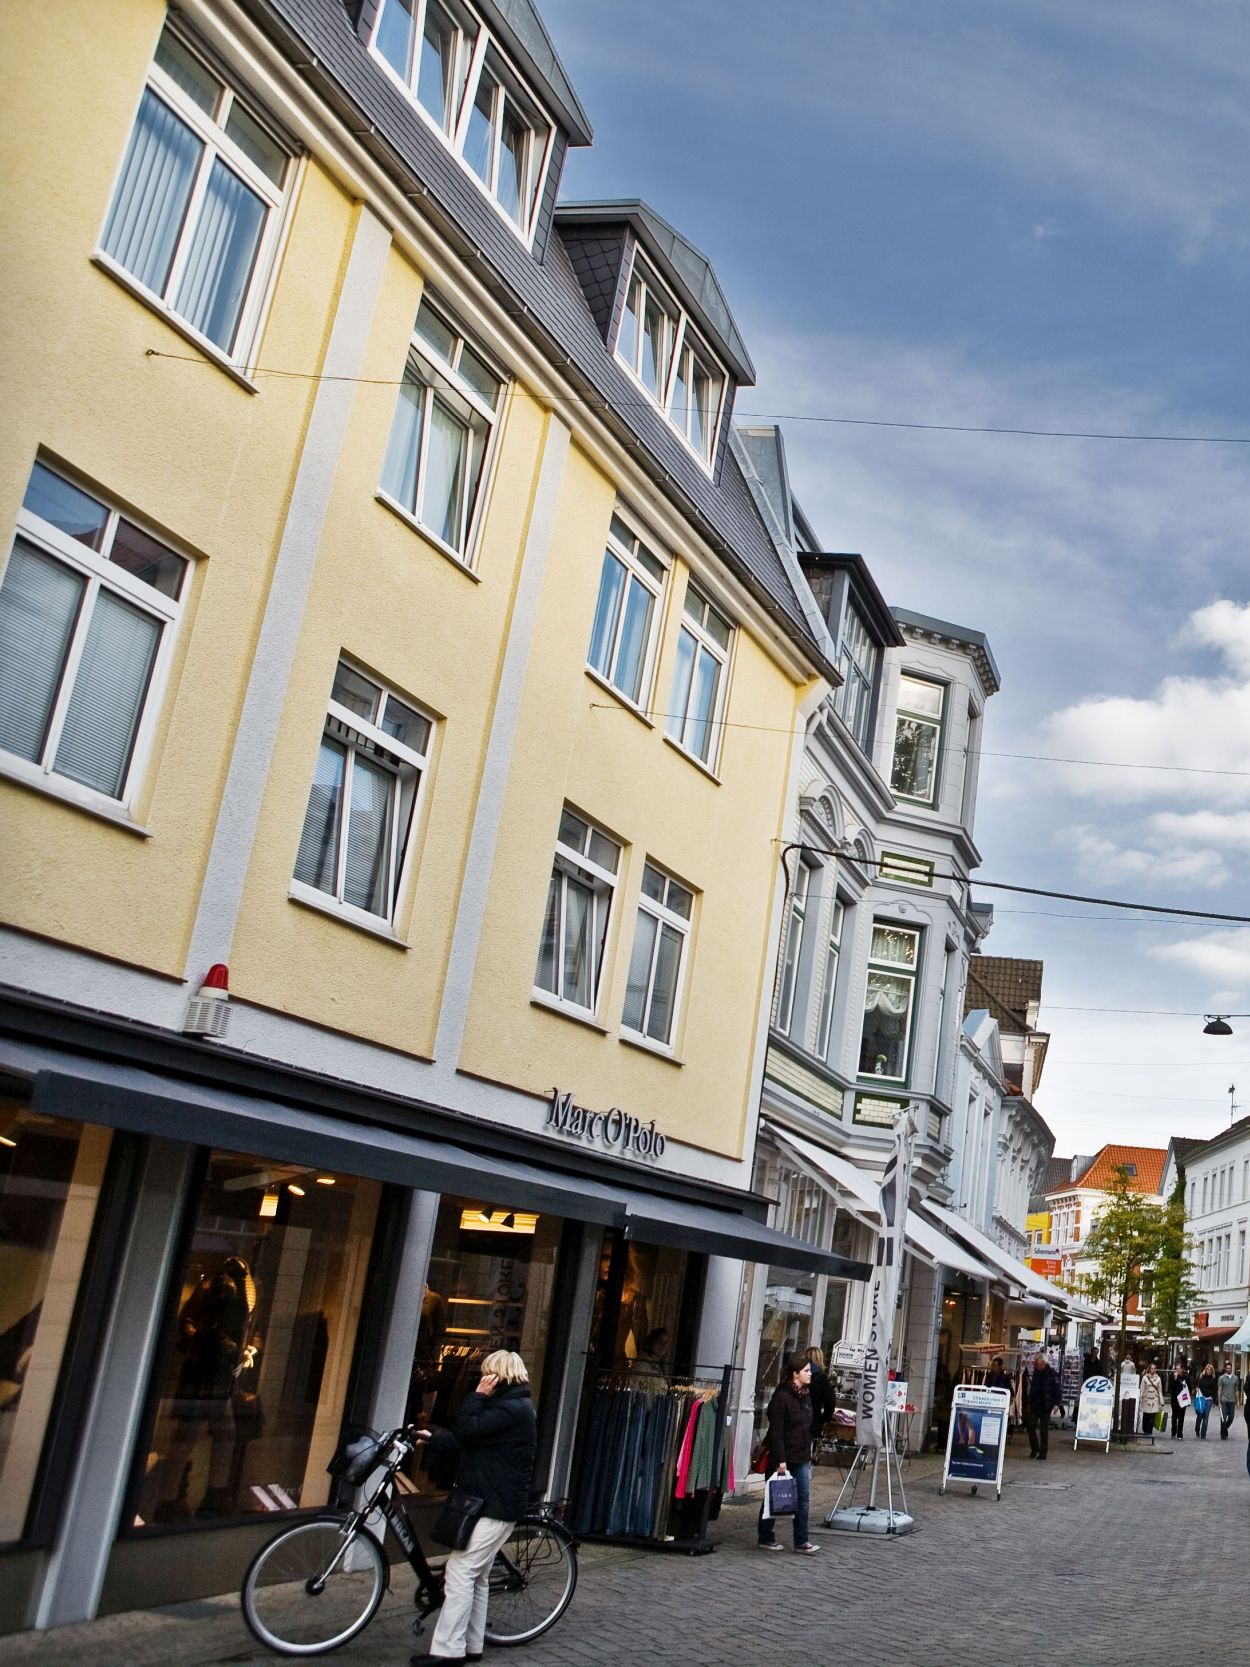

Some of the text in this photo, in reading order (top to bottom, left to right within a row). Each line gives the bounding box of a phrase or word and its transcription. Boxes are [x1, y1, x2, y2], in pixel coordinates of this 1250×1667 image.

[546, 1087, 666, 1157] Marc O'Polo
[862, 1349, 880, 1420] WOMEN
